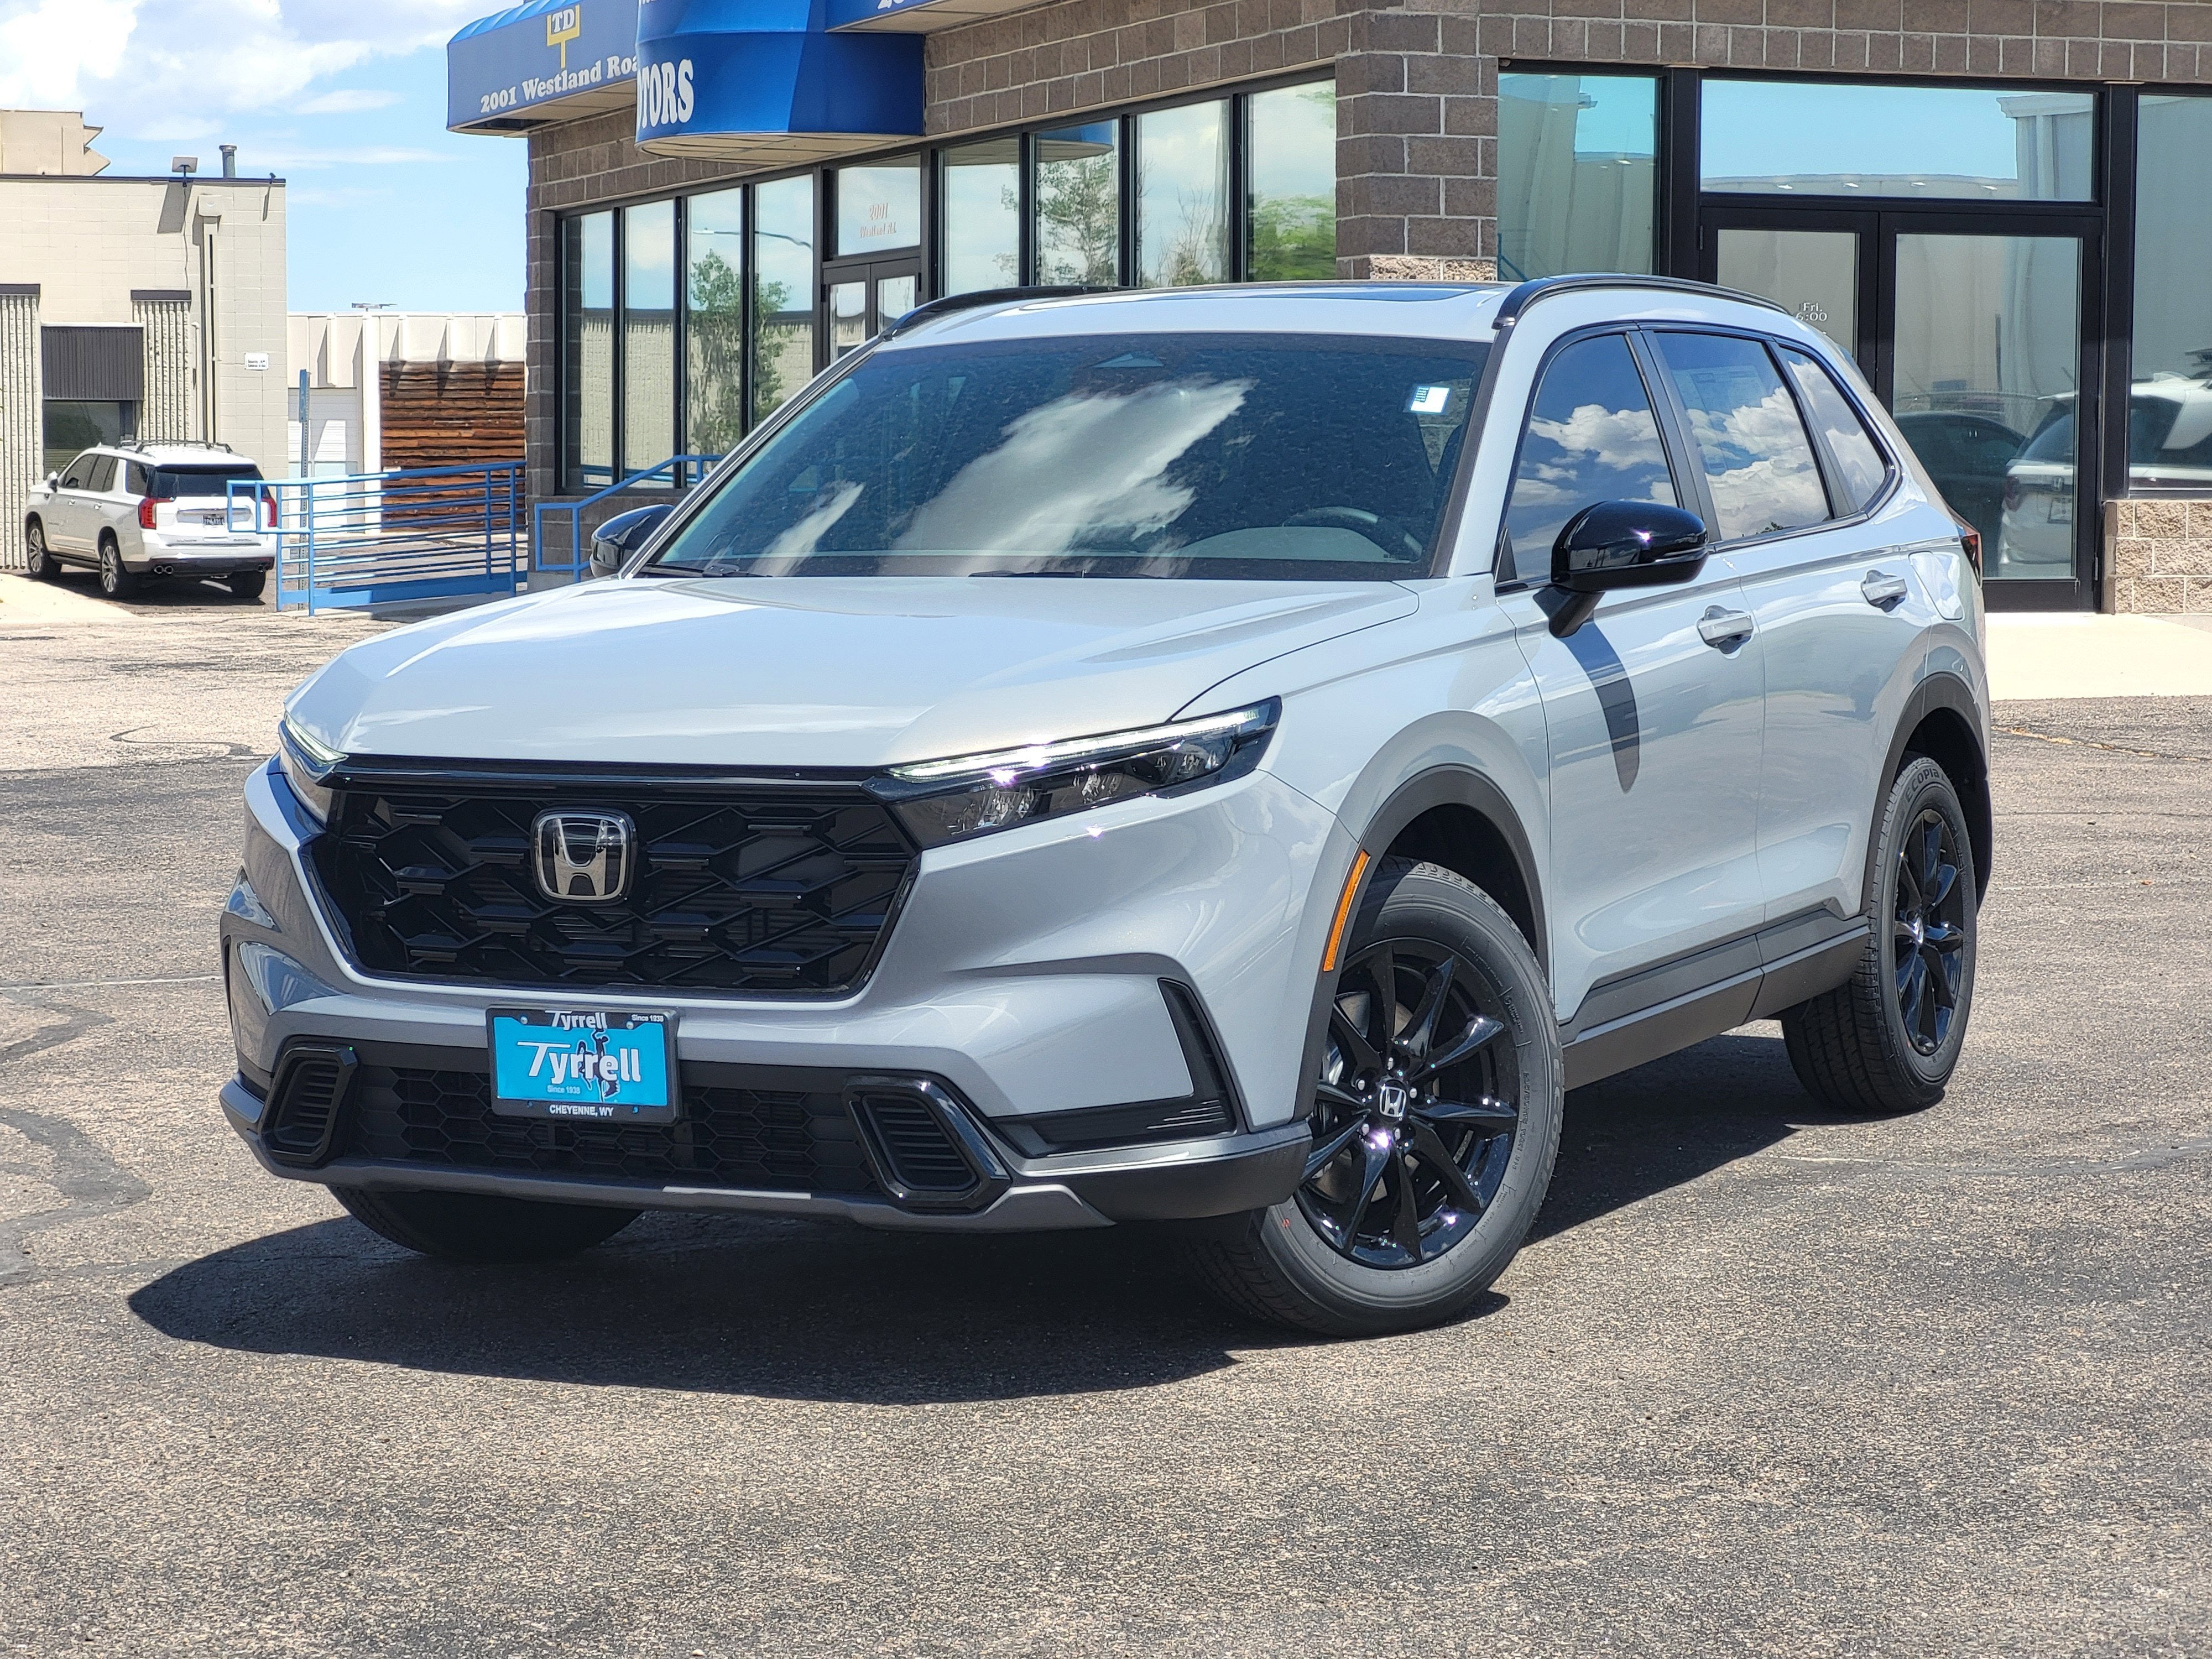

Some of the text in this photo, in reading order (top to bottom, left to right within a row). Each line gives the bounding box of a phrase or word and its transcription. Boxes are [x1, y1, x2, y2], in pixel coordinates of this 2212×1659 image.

[552, 9, 575, 33] TD
[481, 87, 517, 113] 2001
[522, 60, 602, 101] Westland
[1796, 312, 1828, 321] 6:00
[1803, 302, 1823, 311] Fri.
[545, 1010, 608, 1031] Tyrrell
[517, 1041, 641, 1084] Tyrrell
[549, 1104, 614, 1117] CHEYENNE, WY
